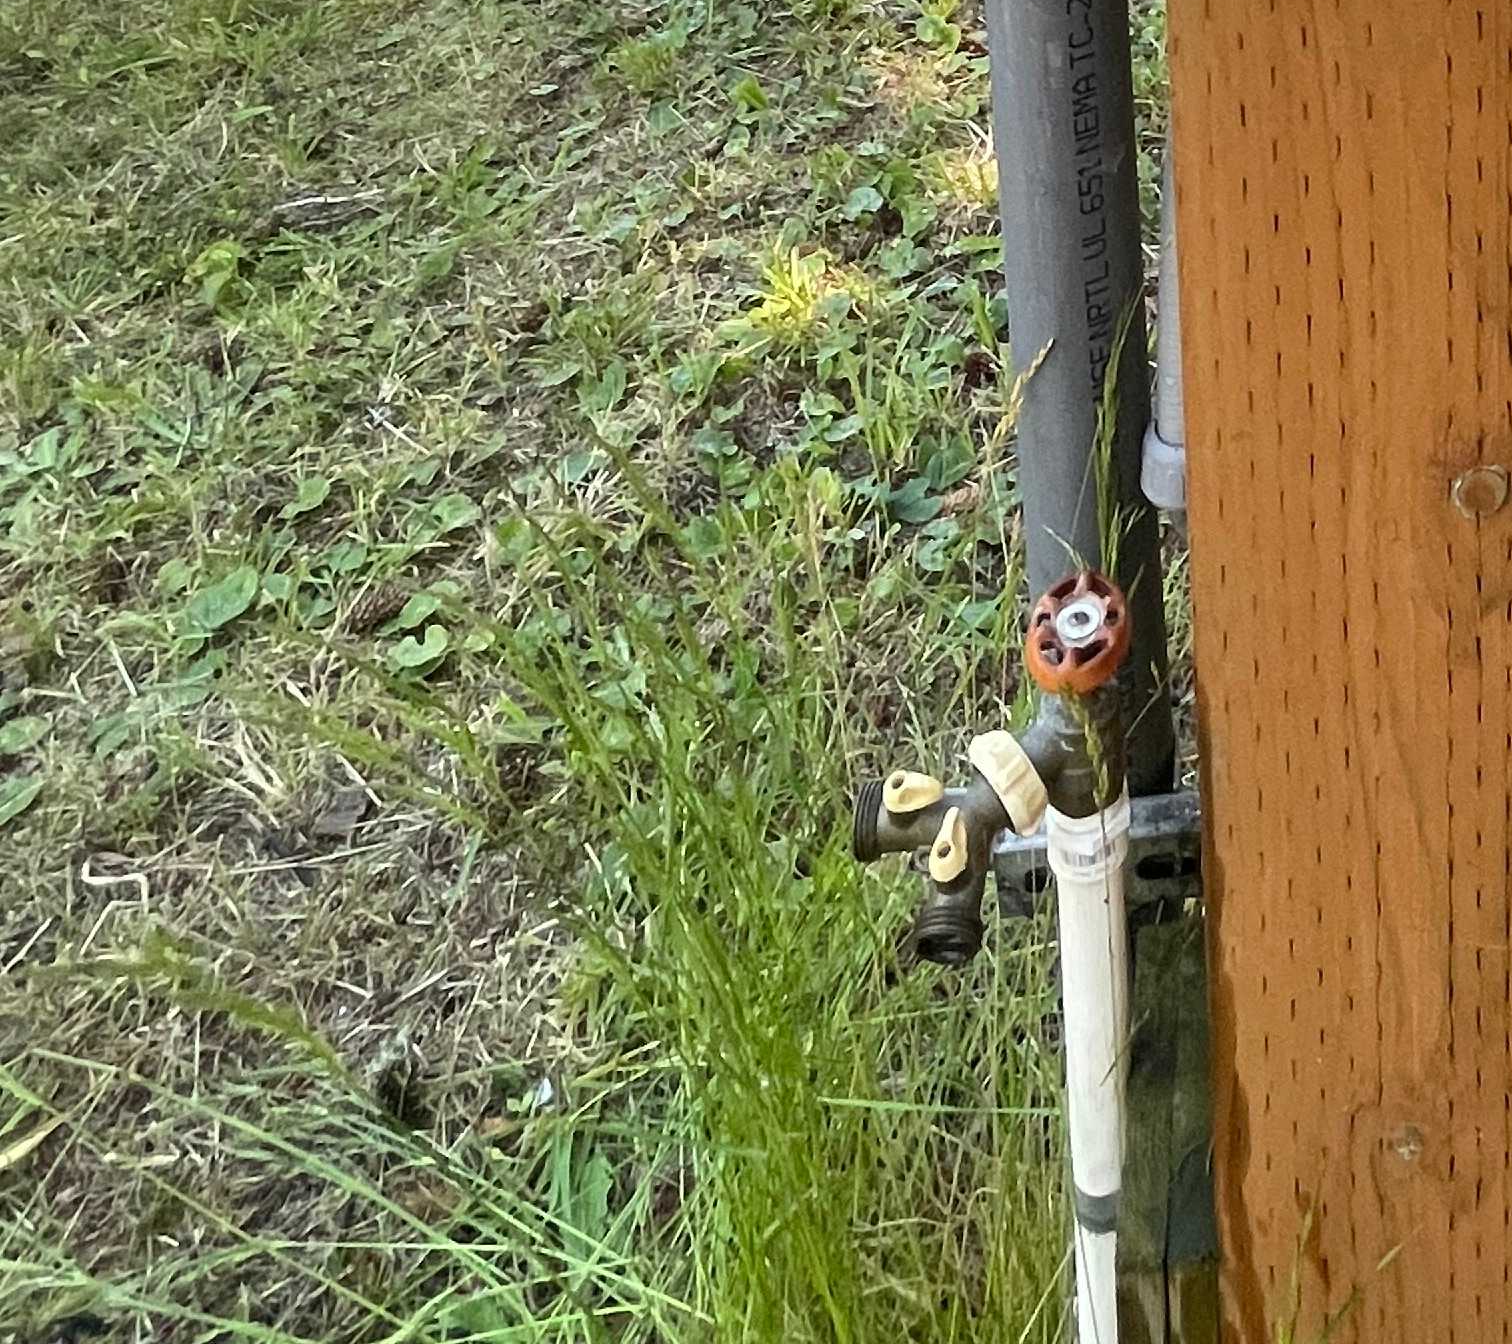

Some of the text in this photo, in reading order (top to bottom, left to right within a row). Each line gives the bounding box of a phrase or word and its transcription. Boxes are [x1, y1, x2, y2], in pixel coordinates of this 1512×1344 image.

[1071, 72, 1101, 158] NEMA
[1077, 158, 1105, 215] 651
[1081, 217, 1107, 261] UL
[1084, 261, 1112, 343] NRTL
